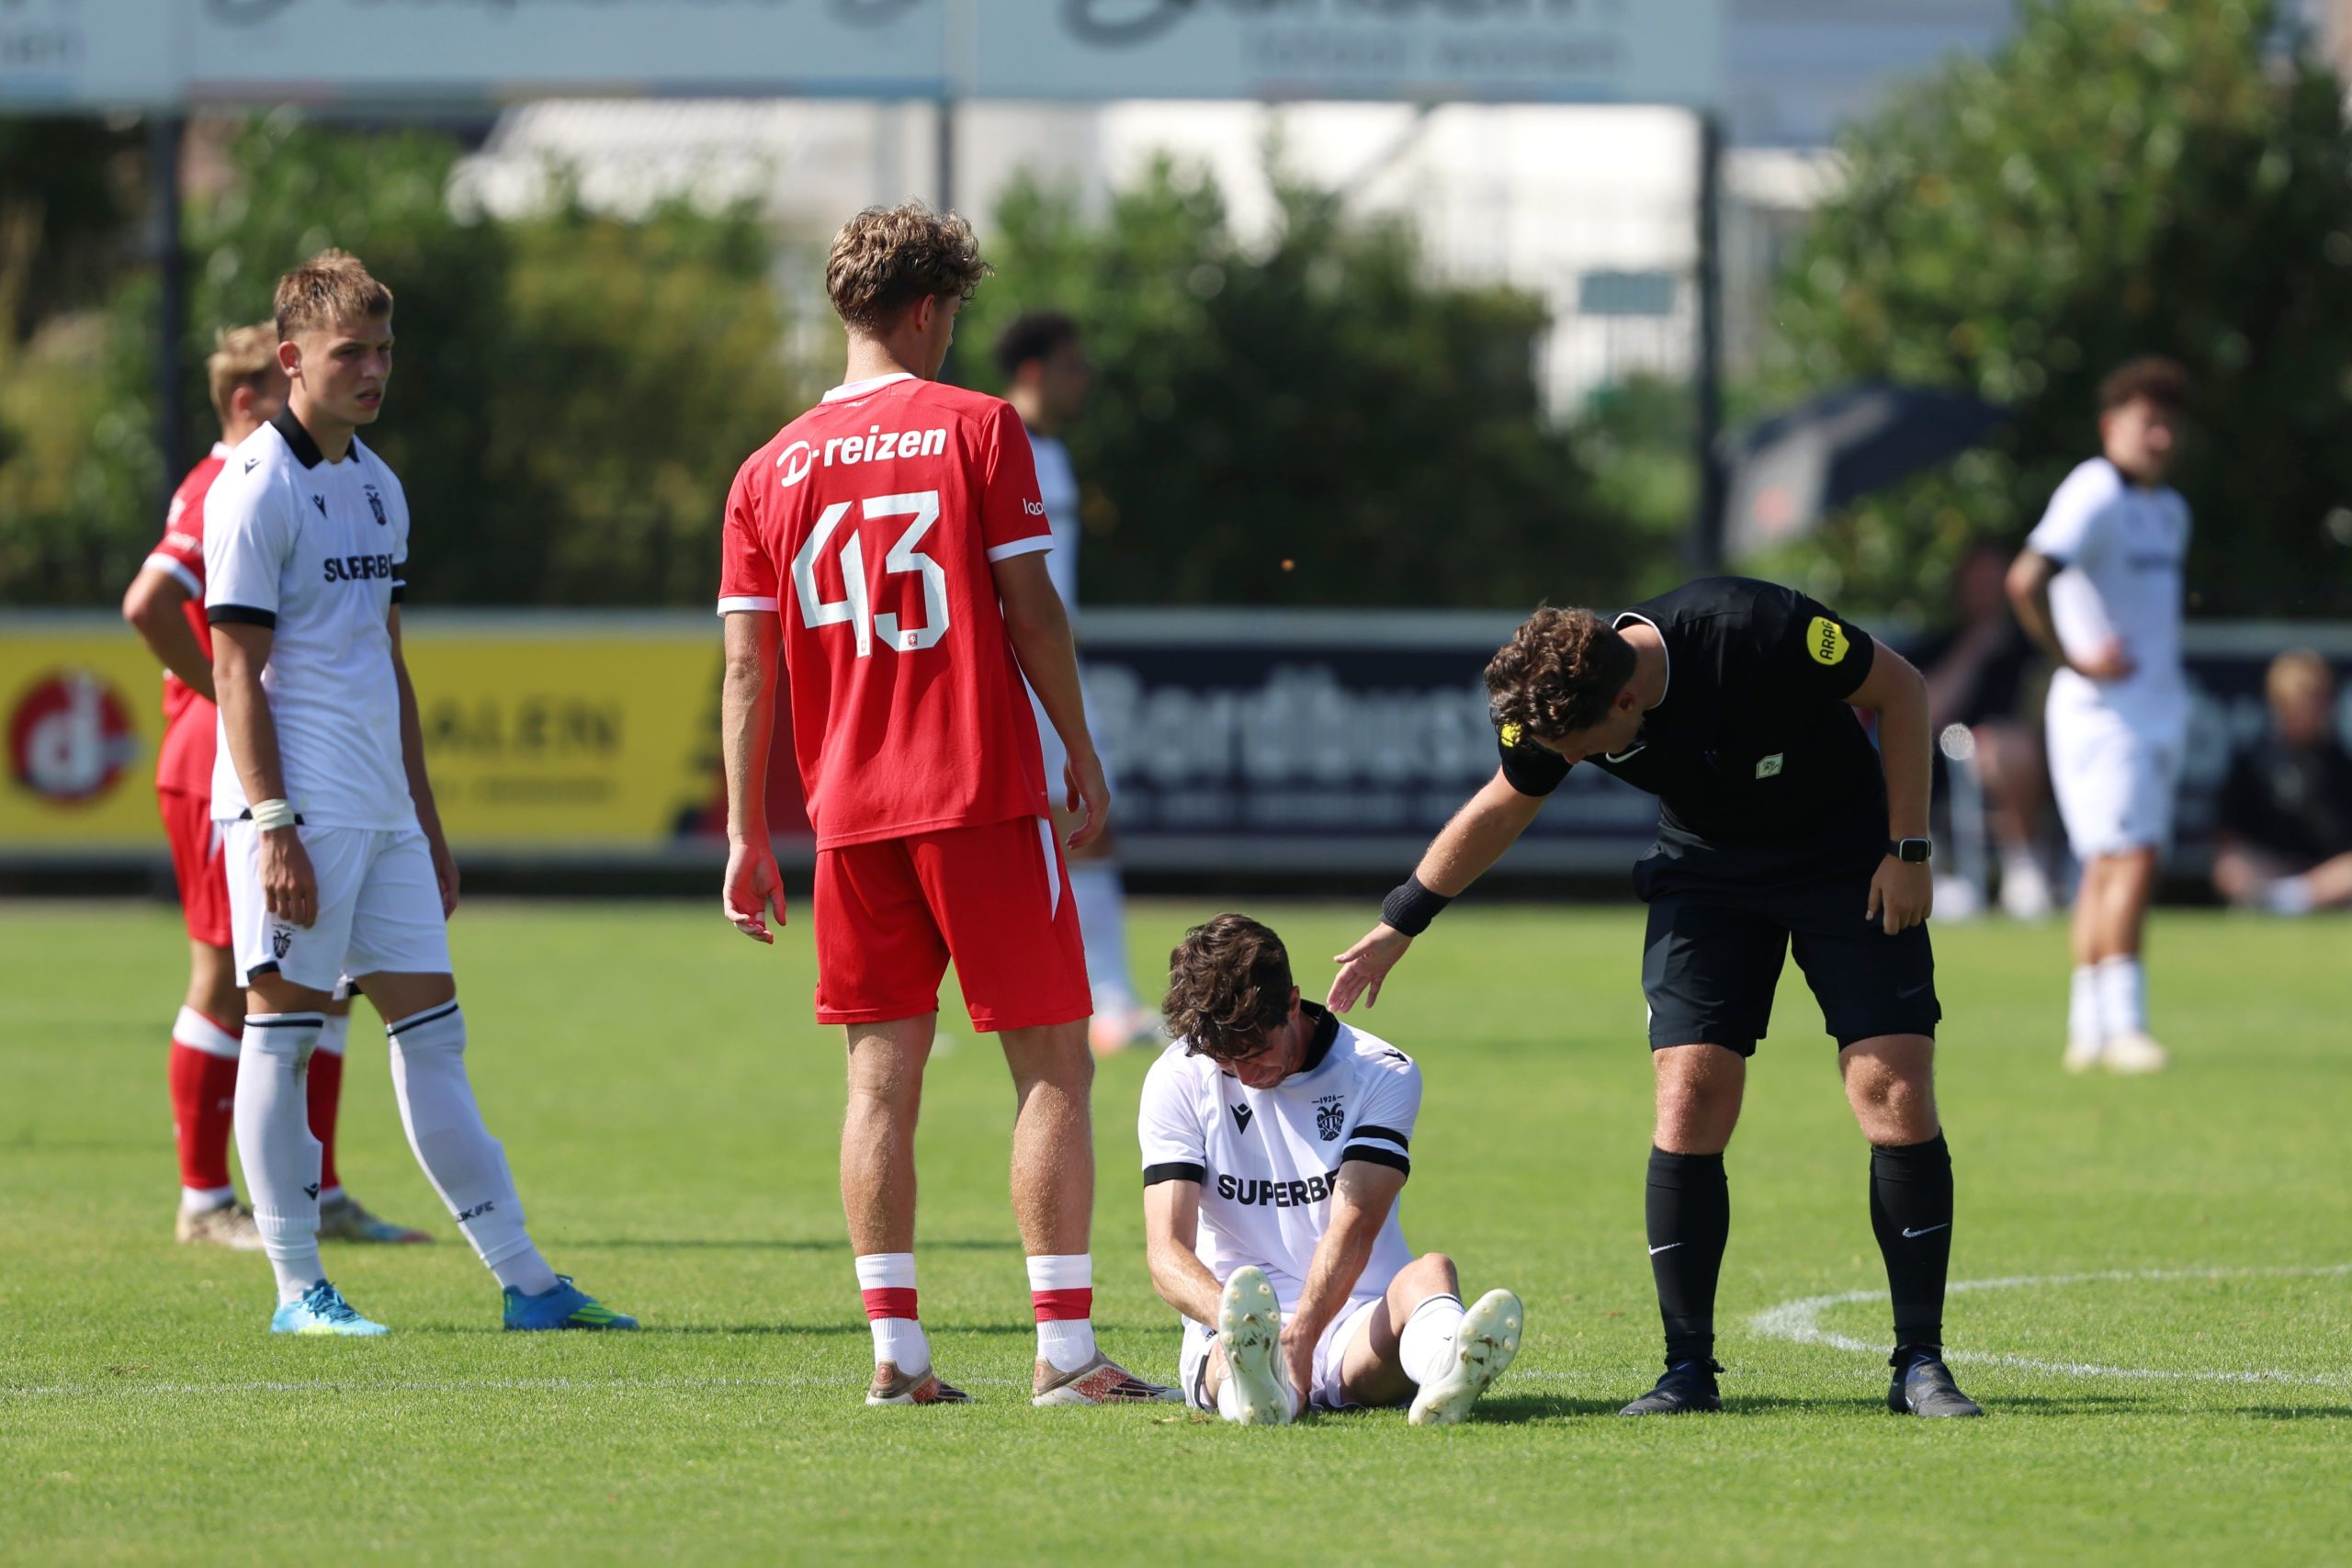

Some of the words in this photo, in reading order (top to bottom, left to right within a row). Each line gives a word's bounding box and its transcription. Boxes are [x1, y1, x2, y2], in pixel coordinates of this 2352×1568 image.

[776, 424, 946, 488] D-reizen
[791, 490, 950, 659] 43
[1819, 620, 1837, 660] ARAG
[424, 695, 625, 761] ALEN
